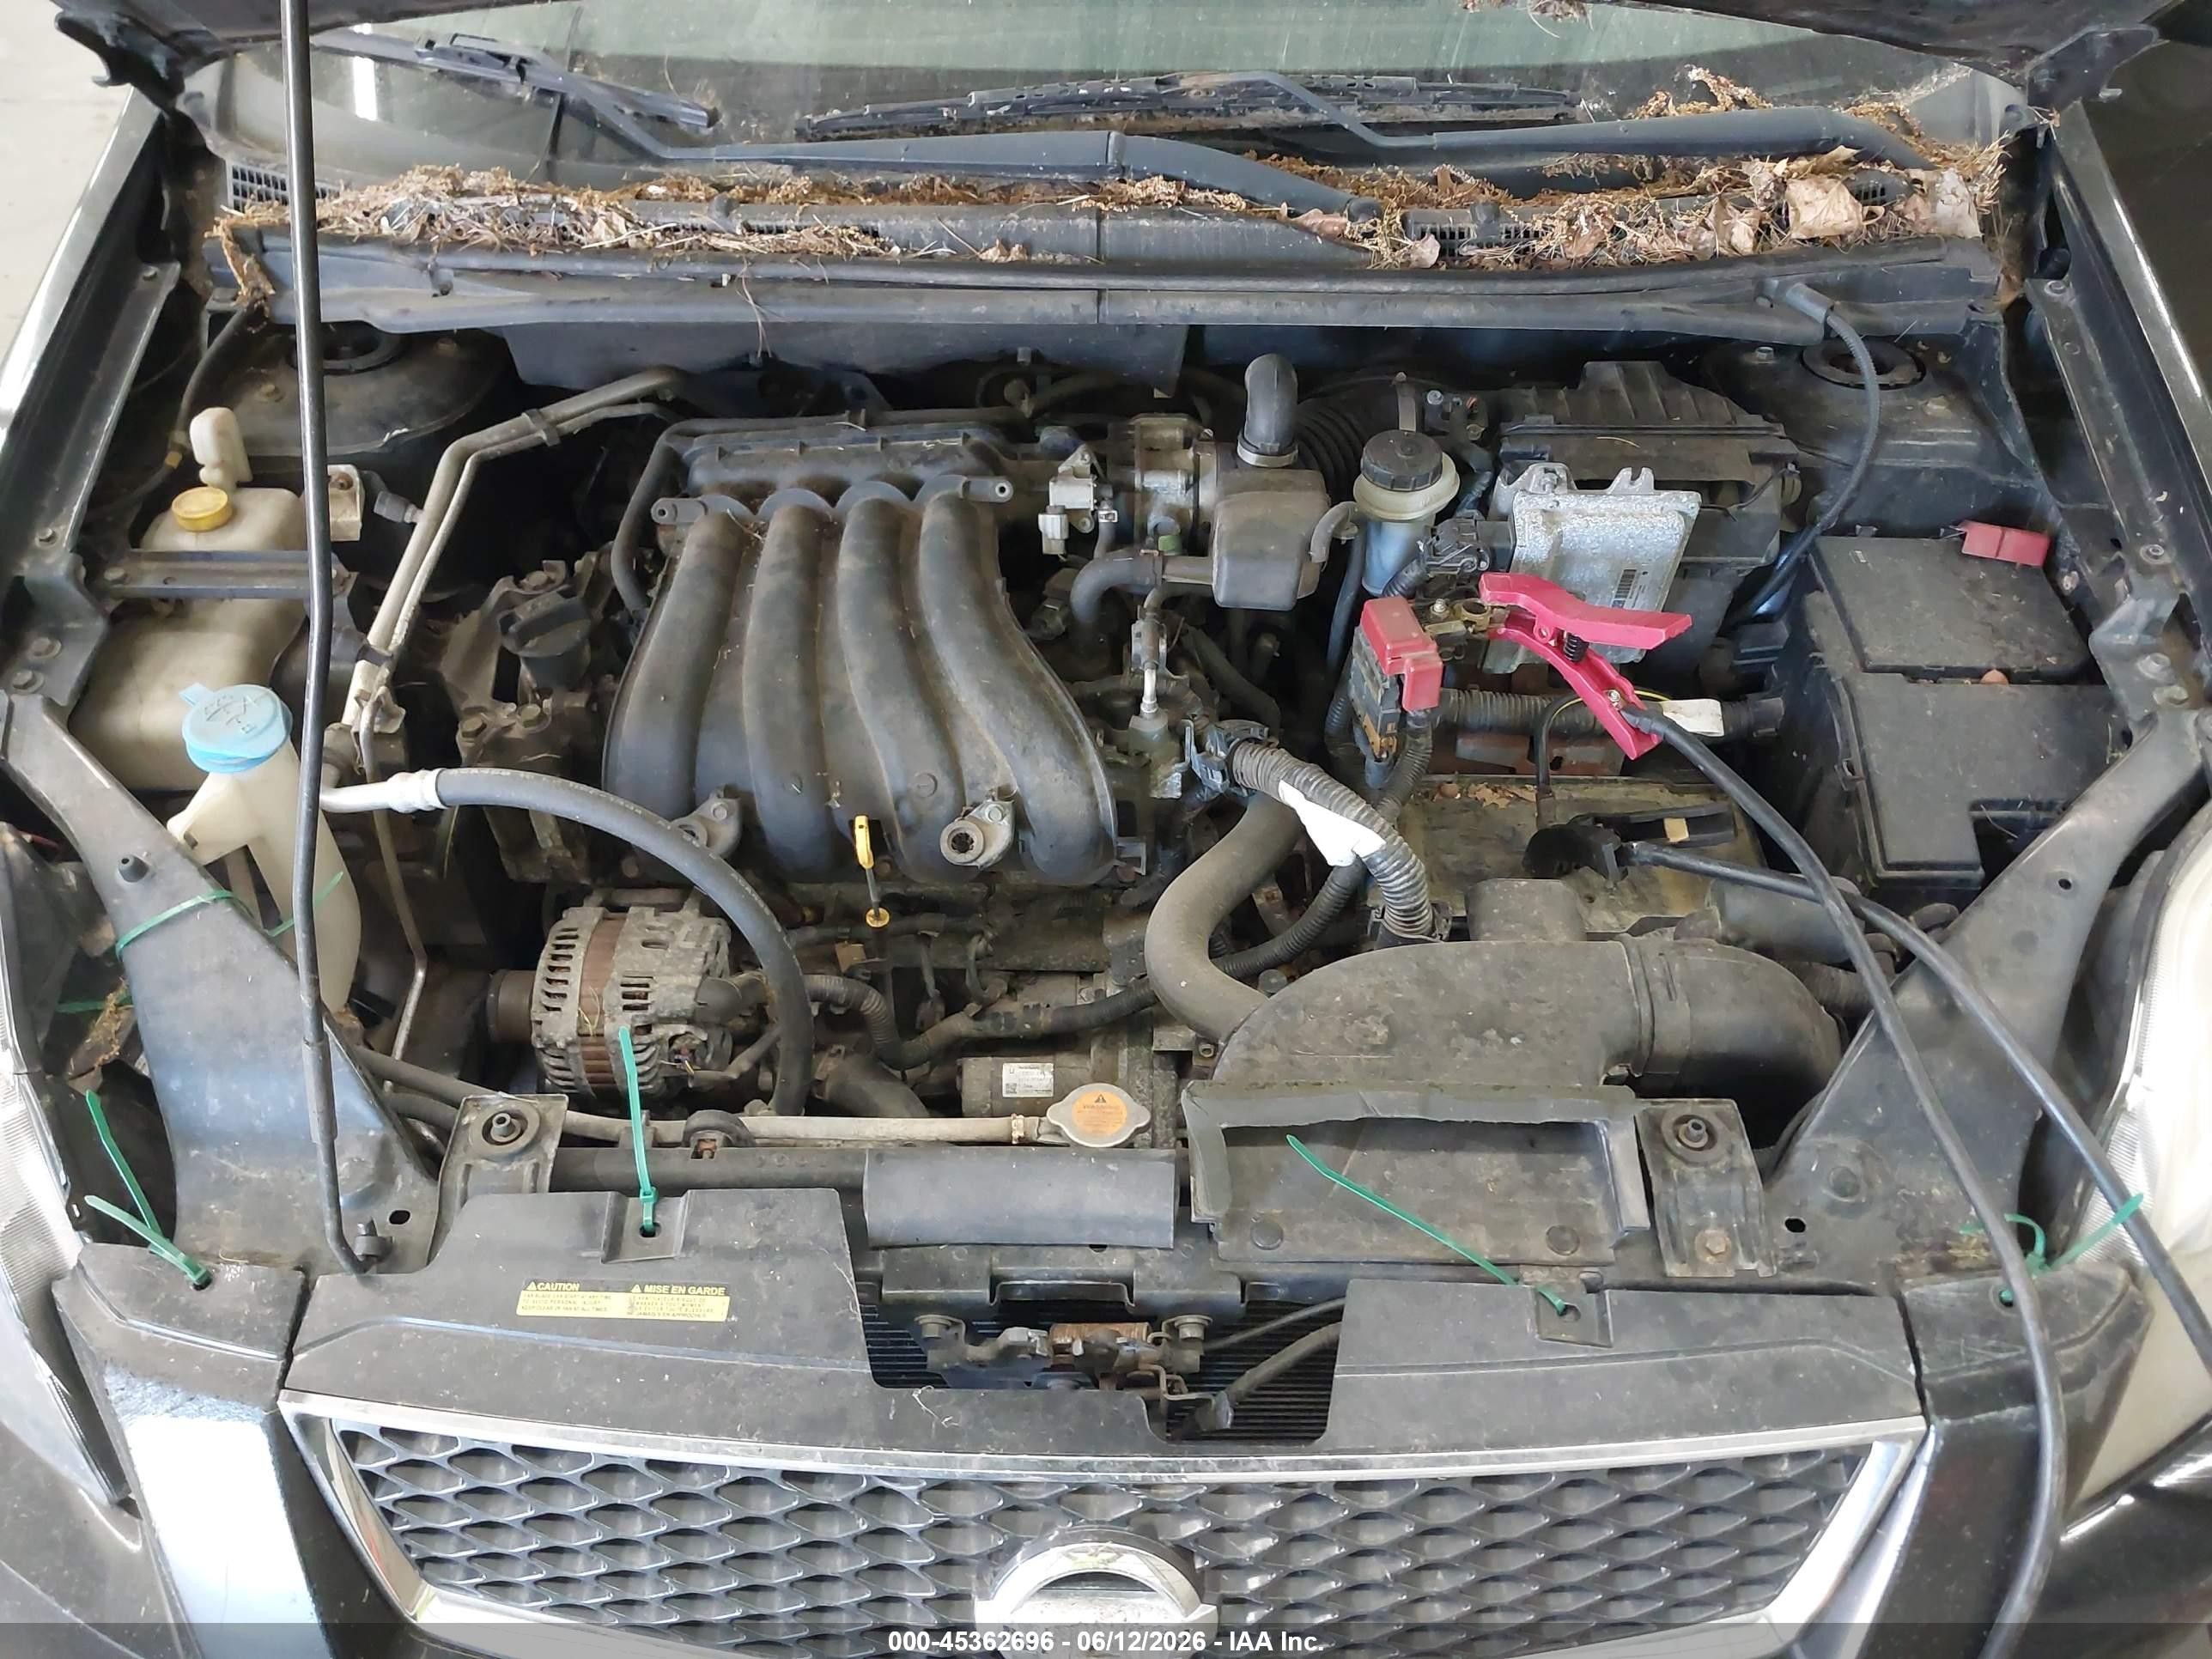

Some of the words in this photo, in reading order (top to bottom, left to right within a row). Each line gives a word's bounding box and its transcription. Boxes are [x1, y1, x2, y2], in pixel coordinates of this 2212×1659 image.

[537, 1282, 580, 1291] CAUTION
[644, 1285, 670, 1293] MISE
[671, 1285, 686, 1294] EN
[688, 1286, 726, 1296] GARDE
